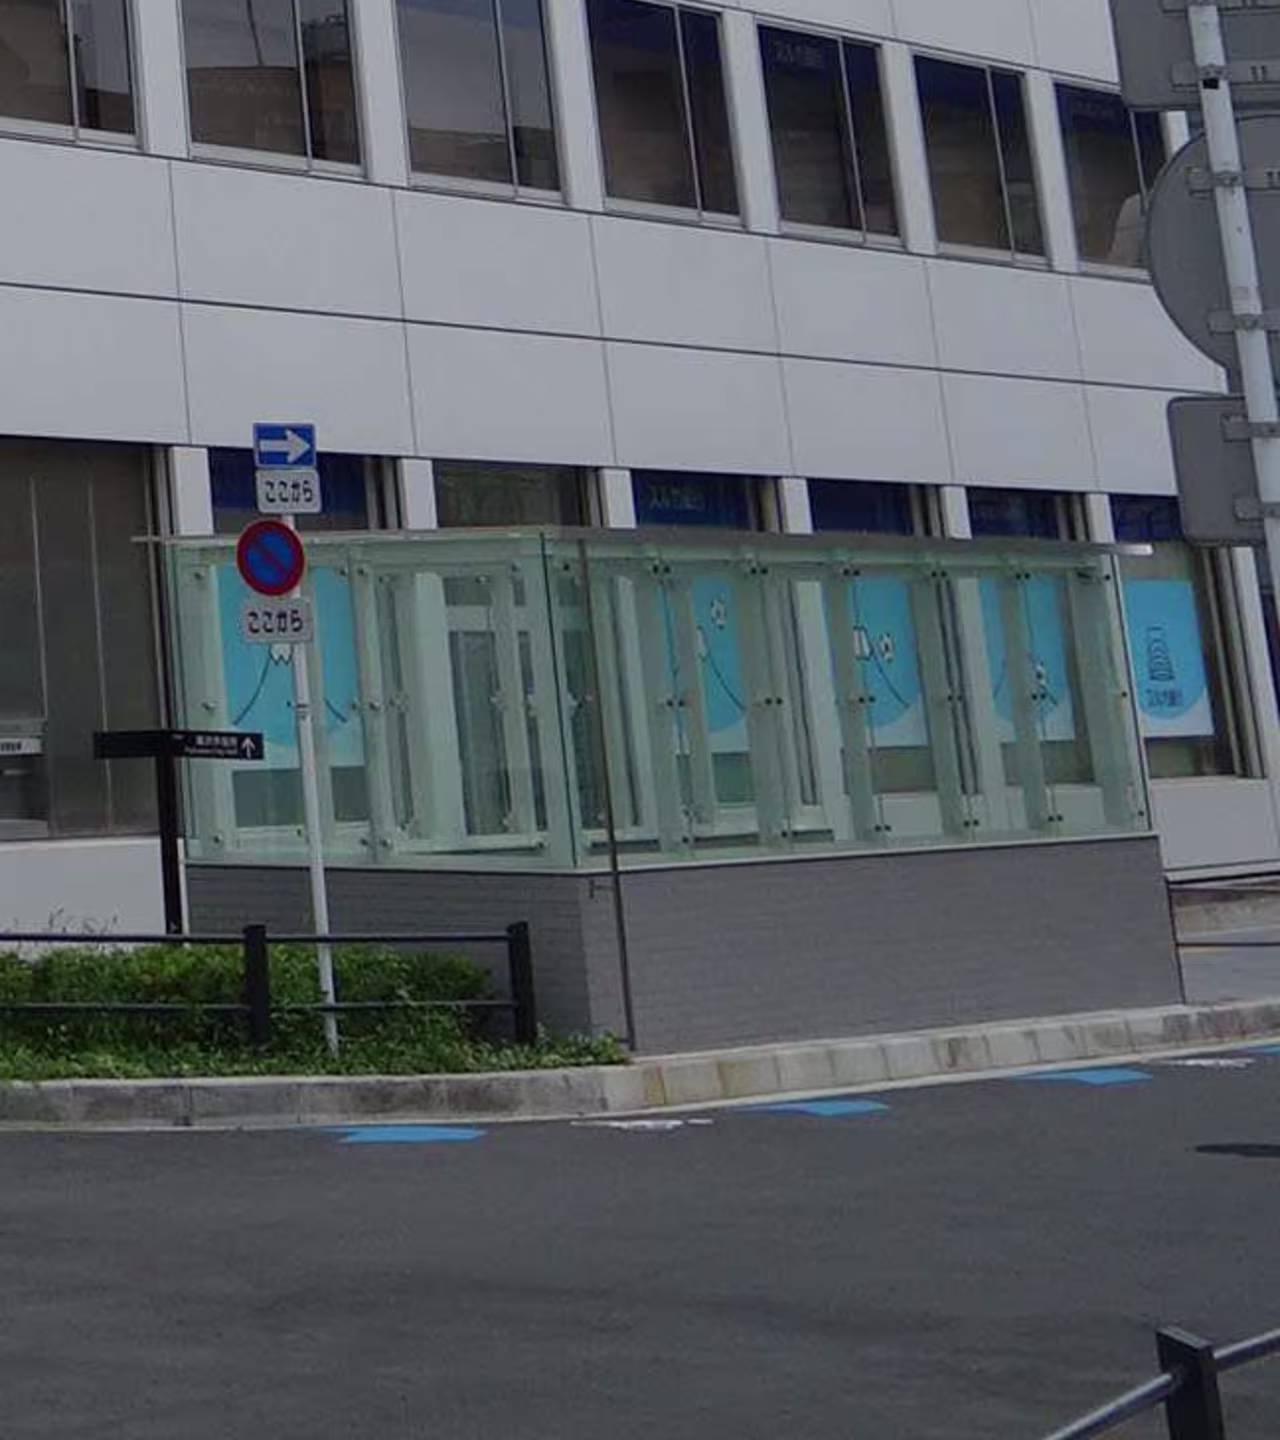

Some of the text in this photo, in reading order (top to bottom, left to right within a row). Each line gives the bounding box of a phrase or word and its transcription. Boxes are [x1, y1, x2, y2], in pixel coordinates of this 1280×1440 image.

[264, 480, 314, 503] ここから
[248, 609, 304, 633] ここから
